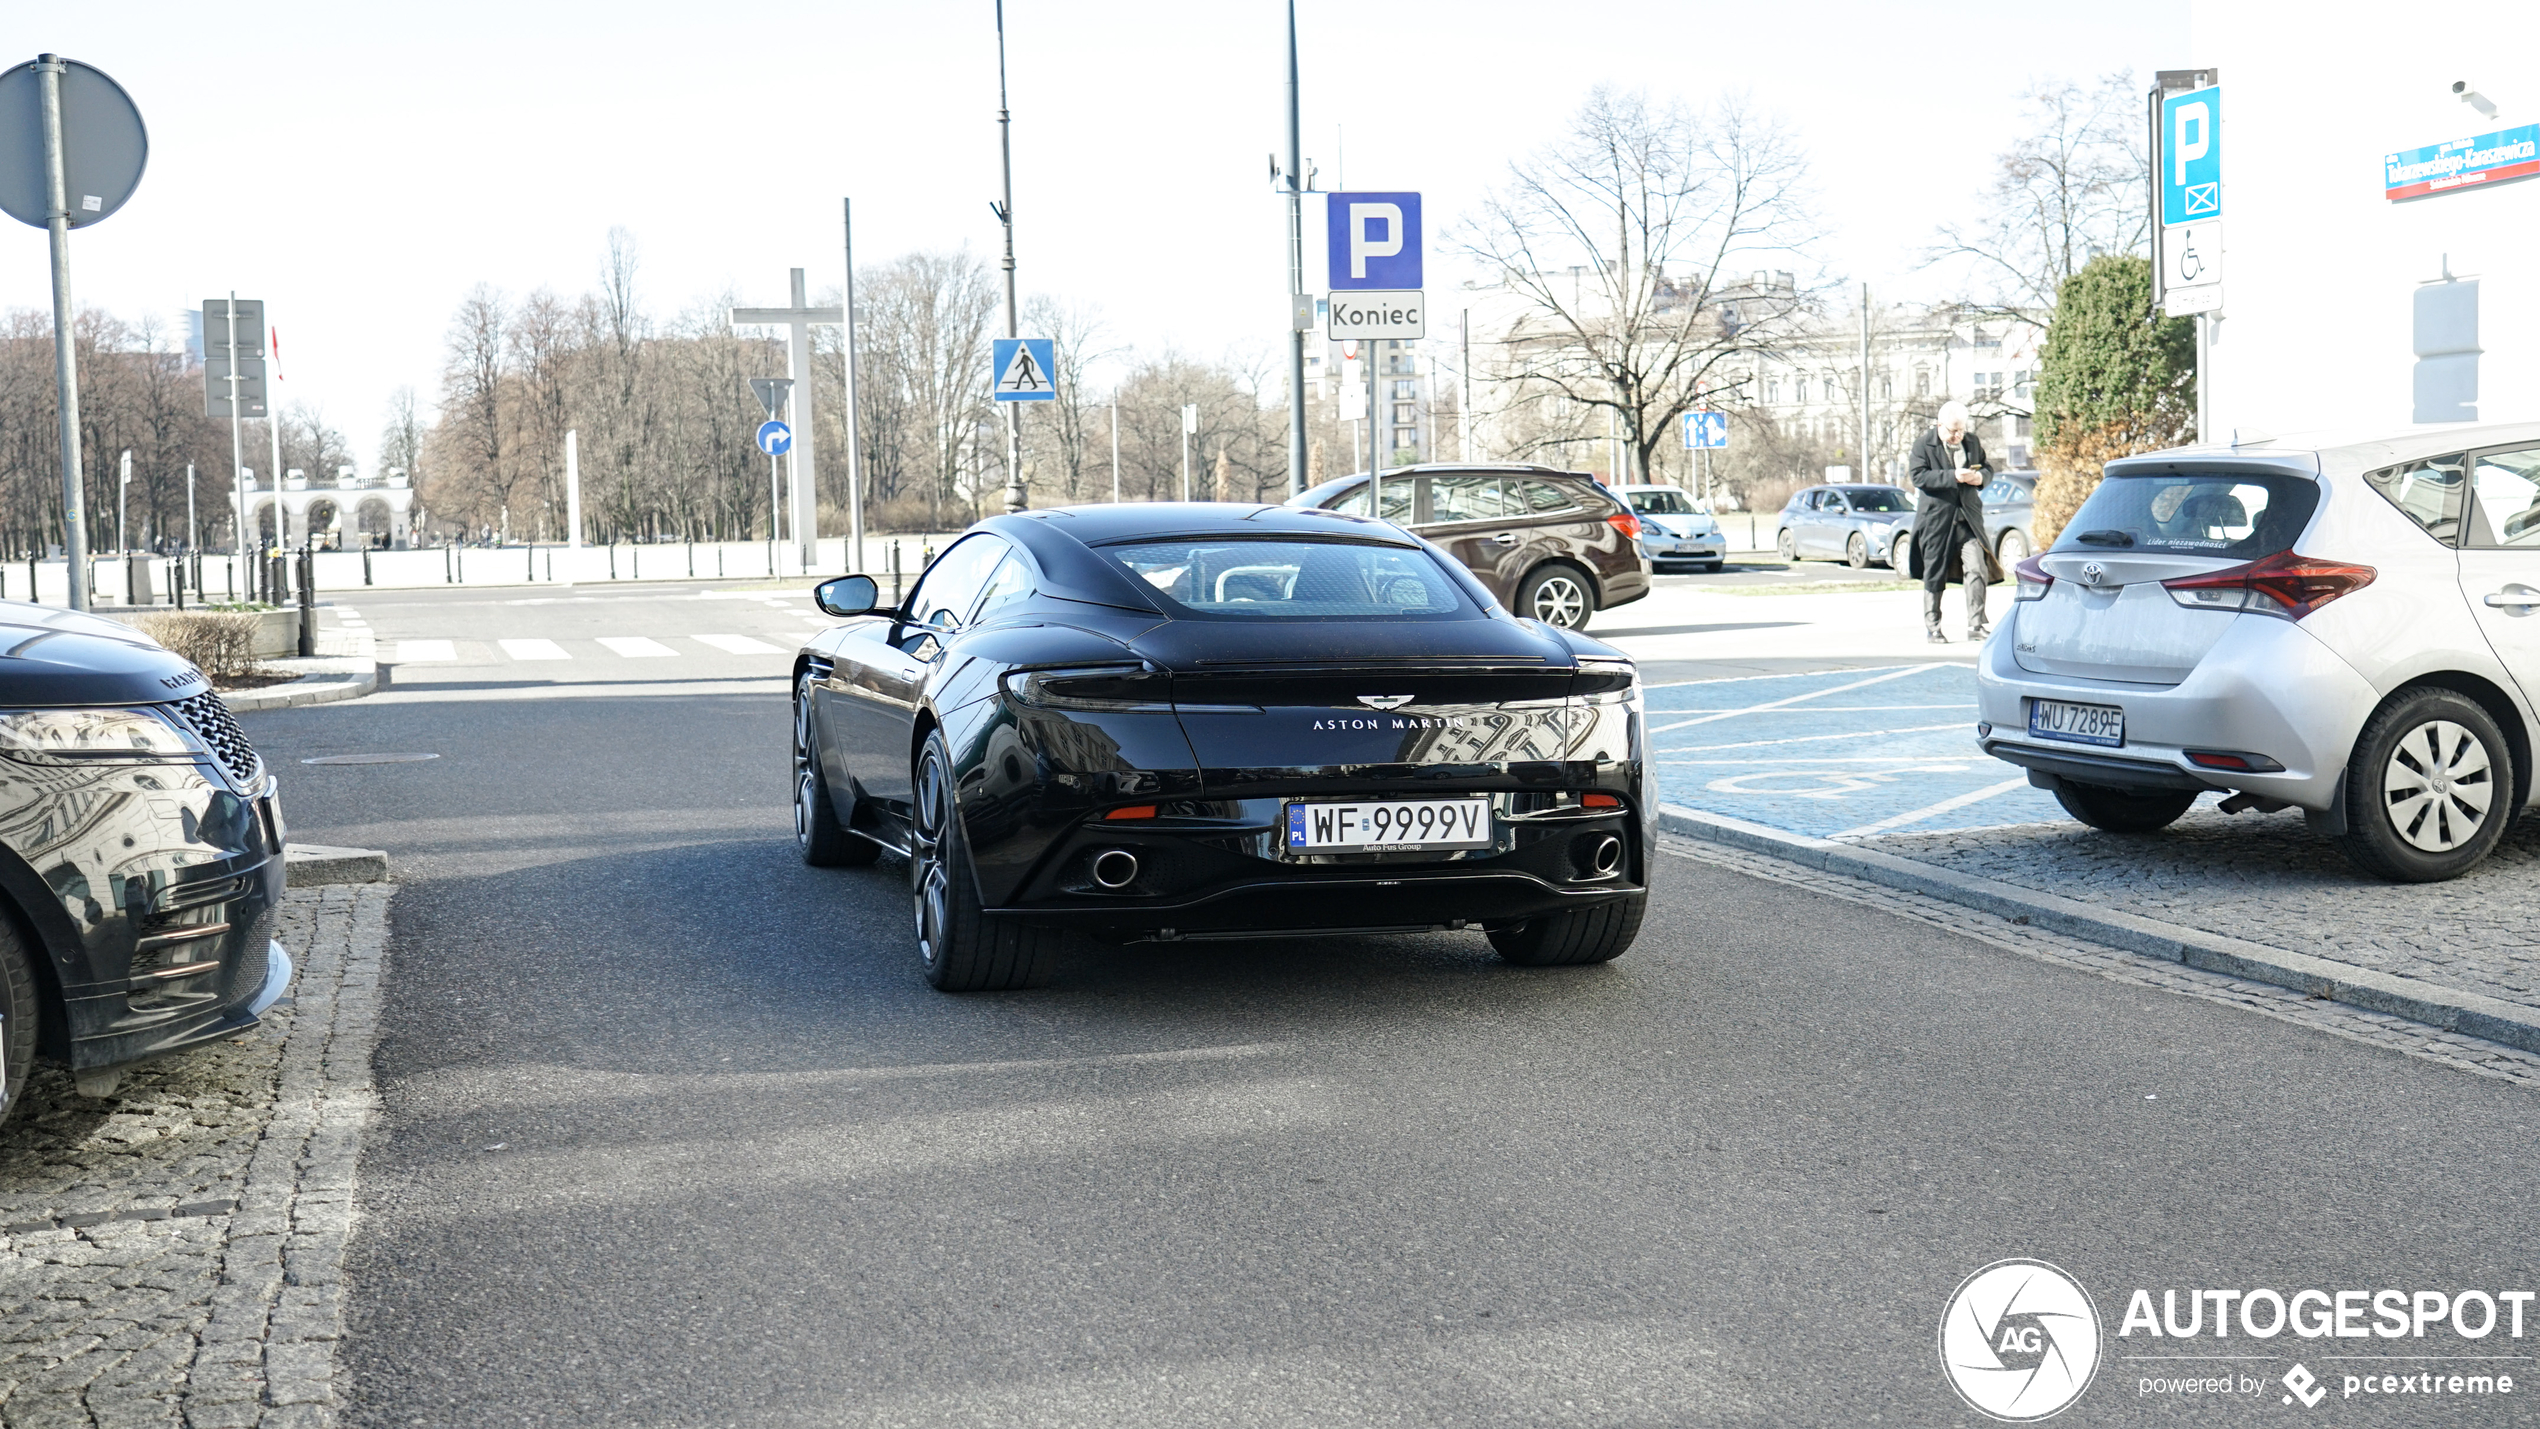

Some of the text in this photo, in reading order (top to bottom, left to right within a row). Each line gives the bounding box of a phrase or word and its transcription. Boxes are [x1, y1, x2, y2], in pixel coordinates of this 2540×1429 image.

[2175, 101, 2209, 186] P
[1350, 203, 1403, 278] P
[1333, 303, 1418, 325] Koniec
[2147, 538, 2167, 546] Lider
[2168, 539, 2228, 549] niezawodności
[1313, 717, 1464, 730] ASTON MARTIN
[2040, 703, 2121, 737] WU 7289E
[1314, 804, 1479, 843] WF 9999V
[1292, 831, 1305, 842] PL
[1362, 843, 1422, 852] Auto Fus Group
